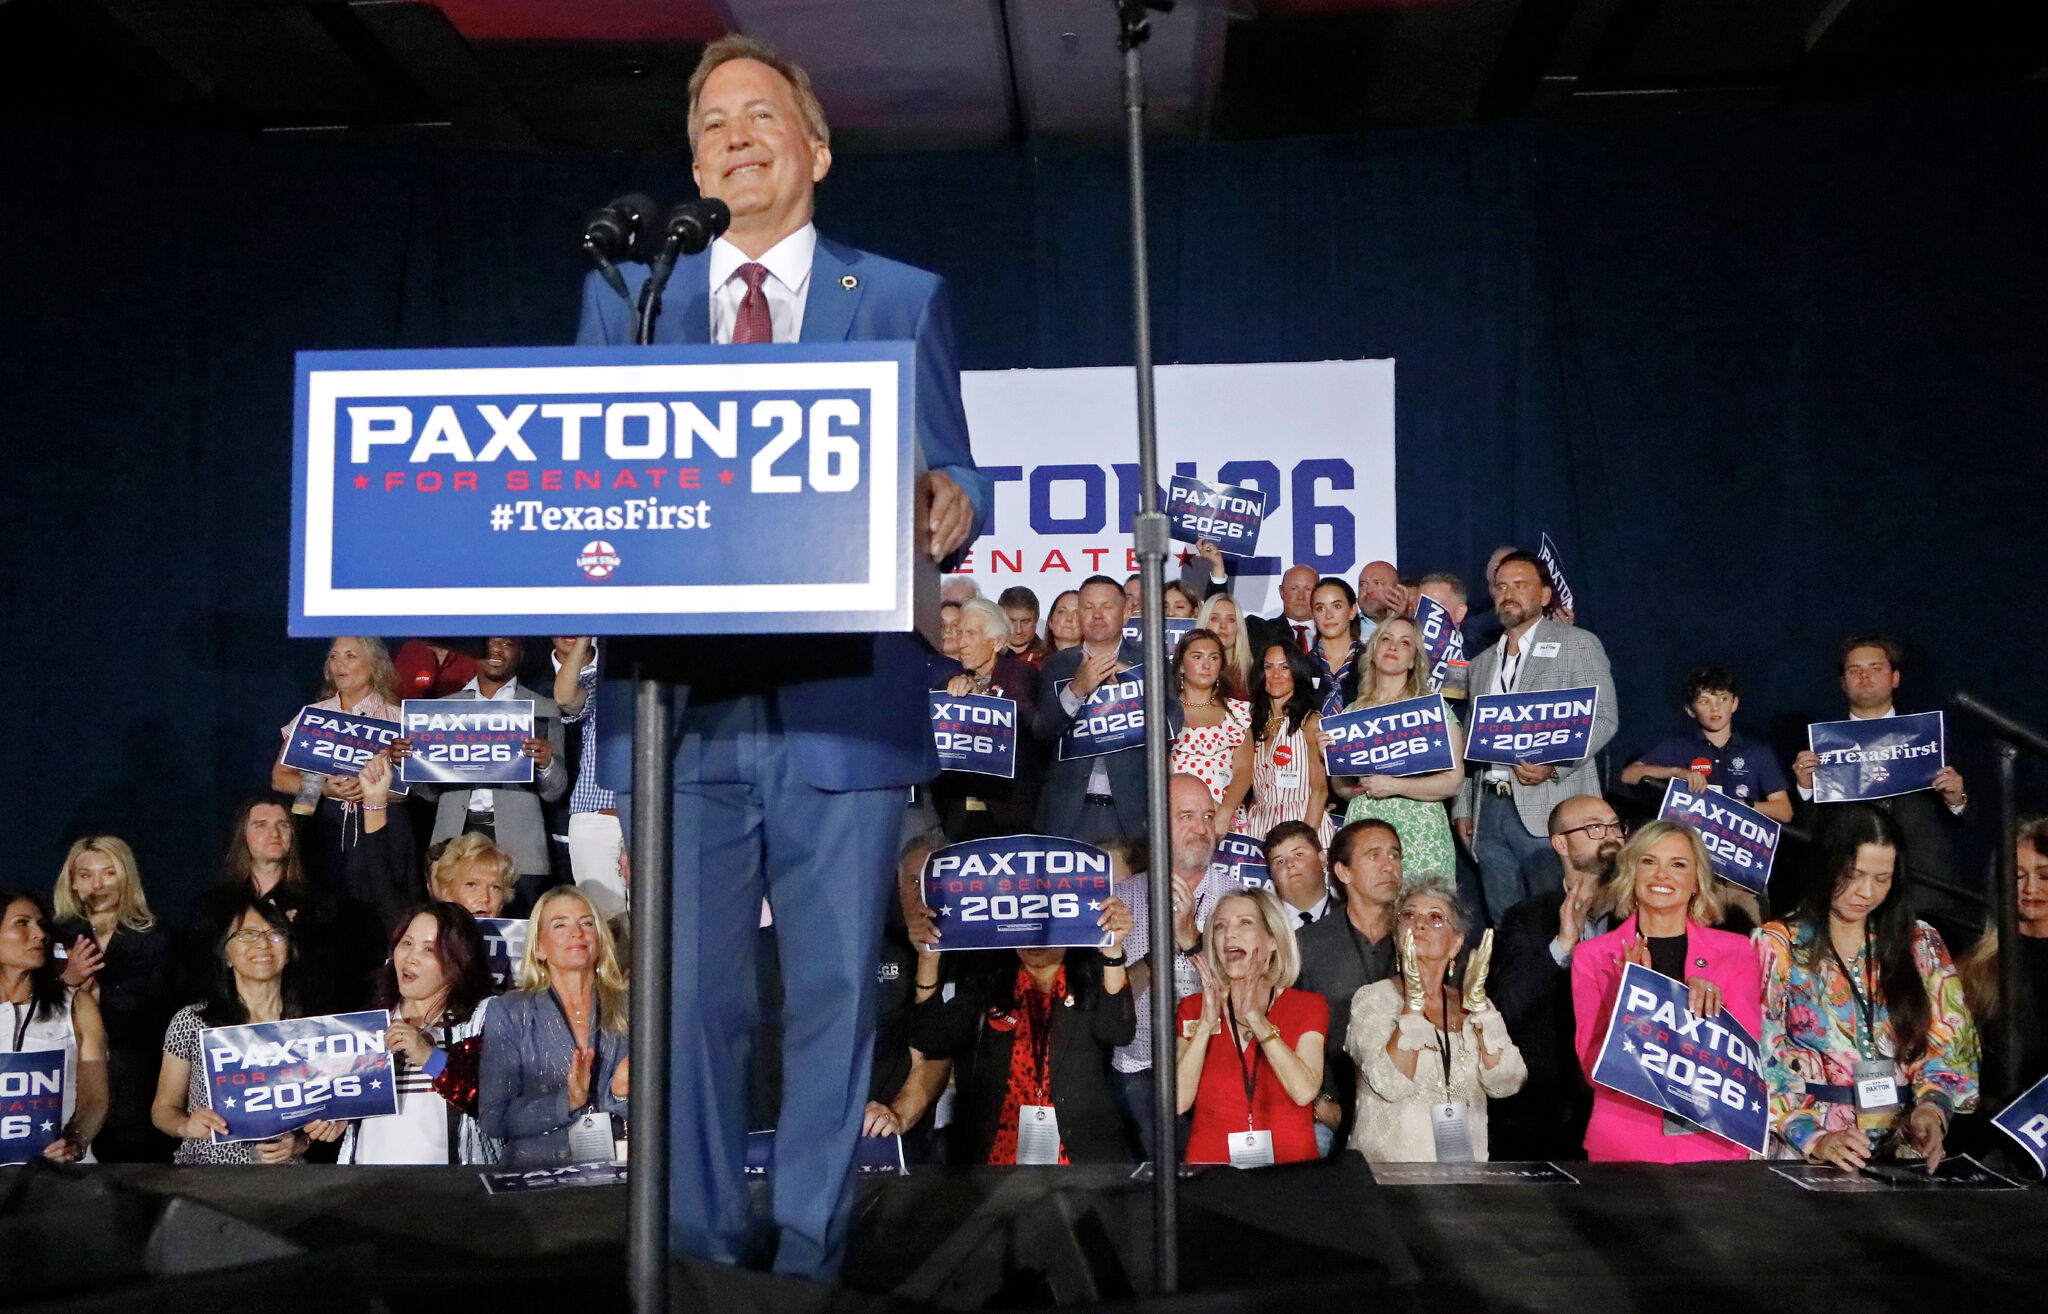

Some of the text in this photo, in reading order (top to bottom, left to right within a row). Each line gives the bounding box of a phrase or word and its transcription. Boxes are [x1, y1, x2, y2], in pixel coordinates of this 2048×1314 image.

[347, 398, 860, 493] PAXTON 26
[385, 469, 702, 492] FOR SENATE
[490, 497, 711, 531] #TexasFirst
[1172, 487, 1262, 517] PAXTON
[1182, 514, 1244, 538] 2026
[1217, 458, 1355, 576] 26
[1086, 679, 1144, 705] XTO
[407, 714, 530, 732] PAXTON
[932, 703, 1012, 728] XTON
[1073, 710, 1144, 738] 2026
[1479, 699, 1593, 723] PAXTON
[1522, 717, 1590, 731] SENATE
[303, 715, 400, 746] PAXTO
[408, 734, 445, 742] FOR
[1325, 706, 1443, 746] PAXTON
[1331, 725, 1444, 752] FOR SENATE
[428, 744, 511, 762] 2026
[1350, 737, 1430, 765] 2026
[1493, 729, 1571, 751] 2026
[1819, 741, 1939, 764] #TexasFirst
[1671, 791, 1775, 849] PAXTON
[1692, 826, 1753, 868] 026
[932, 851, 1105, 878] PAXTON
[932, 876, 1106, 893] FOR SENATE
[960, 893, 1080, 922] 2026
[1626, 984, 1764, 1080] PAXTON
[210, 1029, 385, 1072] PAXTON
[1623, 1014, 1771, 1094] FOR SENATE
[0, 1069, 60, 1098] ON
[216, 1071, 266, 1087] FOR
[1640, 1042, 1747, 1111] 2026
[1865, 1084, 1890, 1093] PAXTON
[244, 1076, 362, 1112] 2026
[1, 1115, 31, 1140] 6
